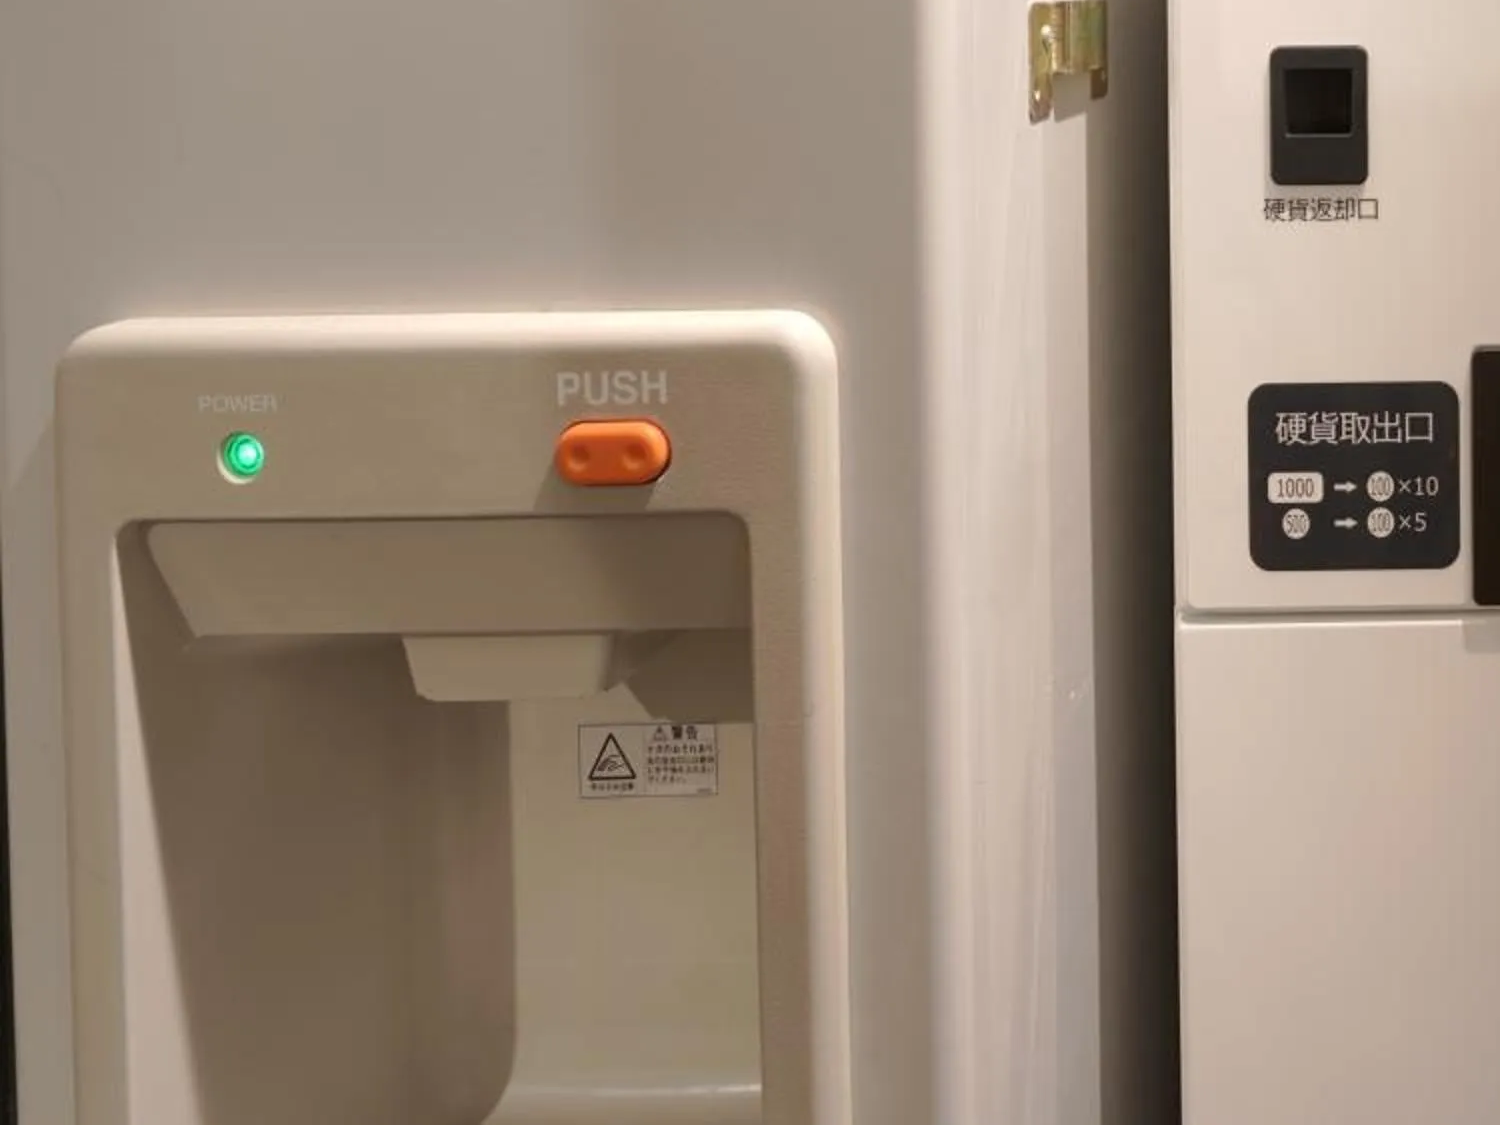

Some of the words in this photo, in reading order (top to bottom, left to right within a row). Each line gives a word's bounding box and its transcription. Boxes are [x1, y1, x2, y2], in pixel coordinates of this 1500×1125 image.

[1263, 197, 1379, 222] 硬貨返却口
[556, 370, 668, 405] PUSH
[198, 394, 277, 412] POWER
[1275, 411, 1434, 446] 硬貨取出口
[1276, 478, 1315, 498] 1000
[1370, 477, 1392, 496] 100
[1286, 514, 1308, 534] 500
[1370, 513, 1392, 532] 100
